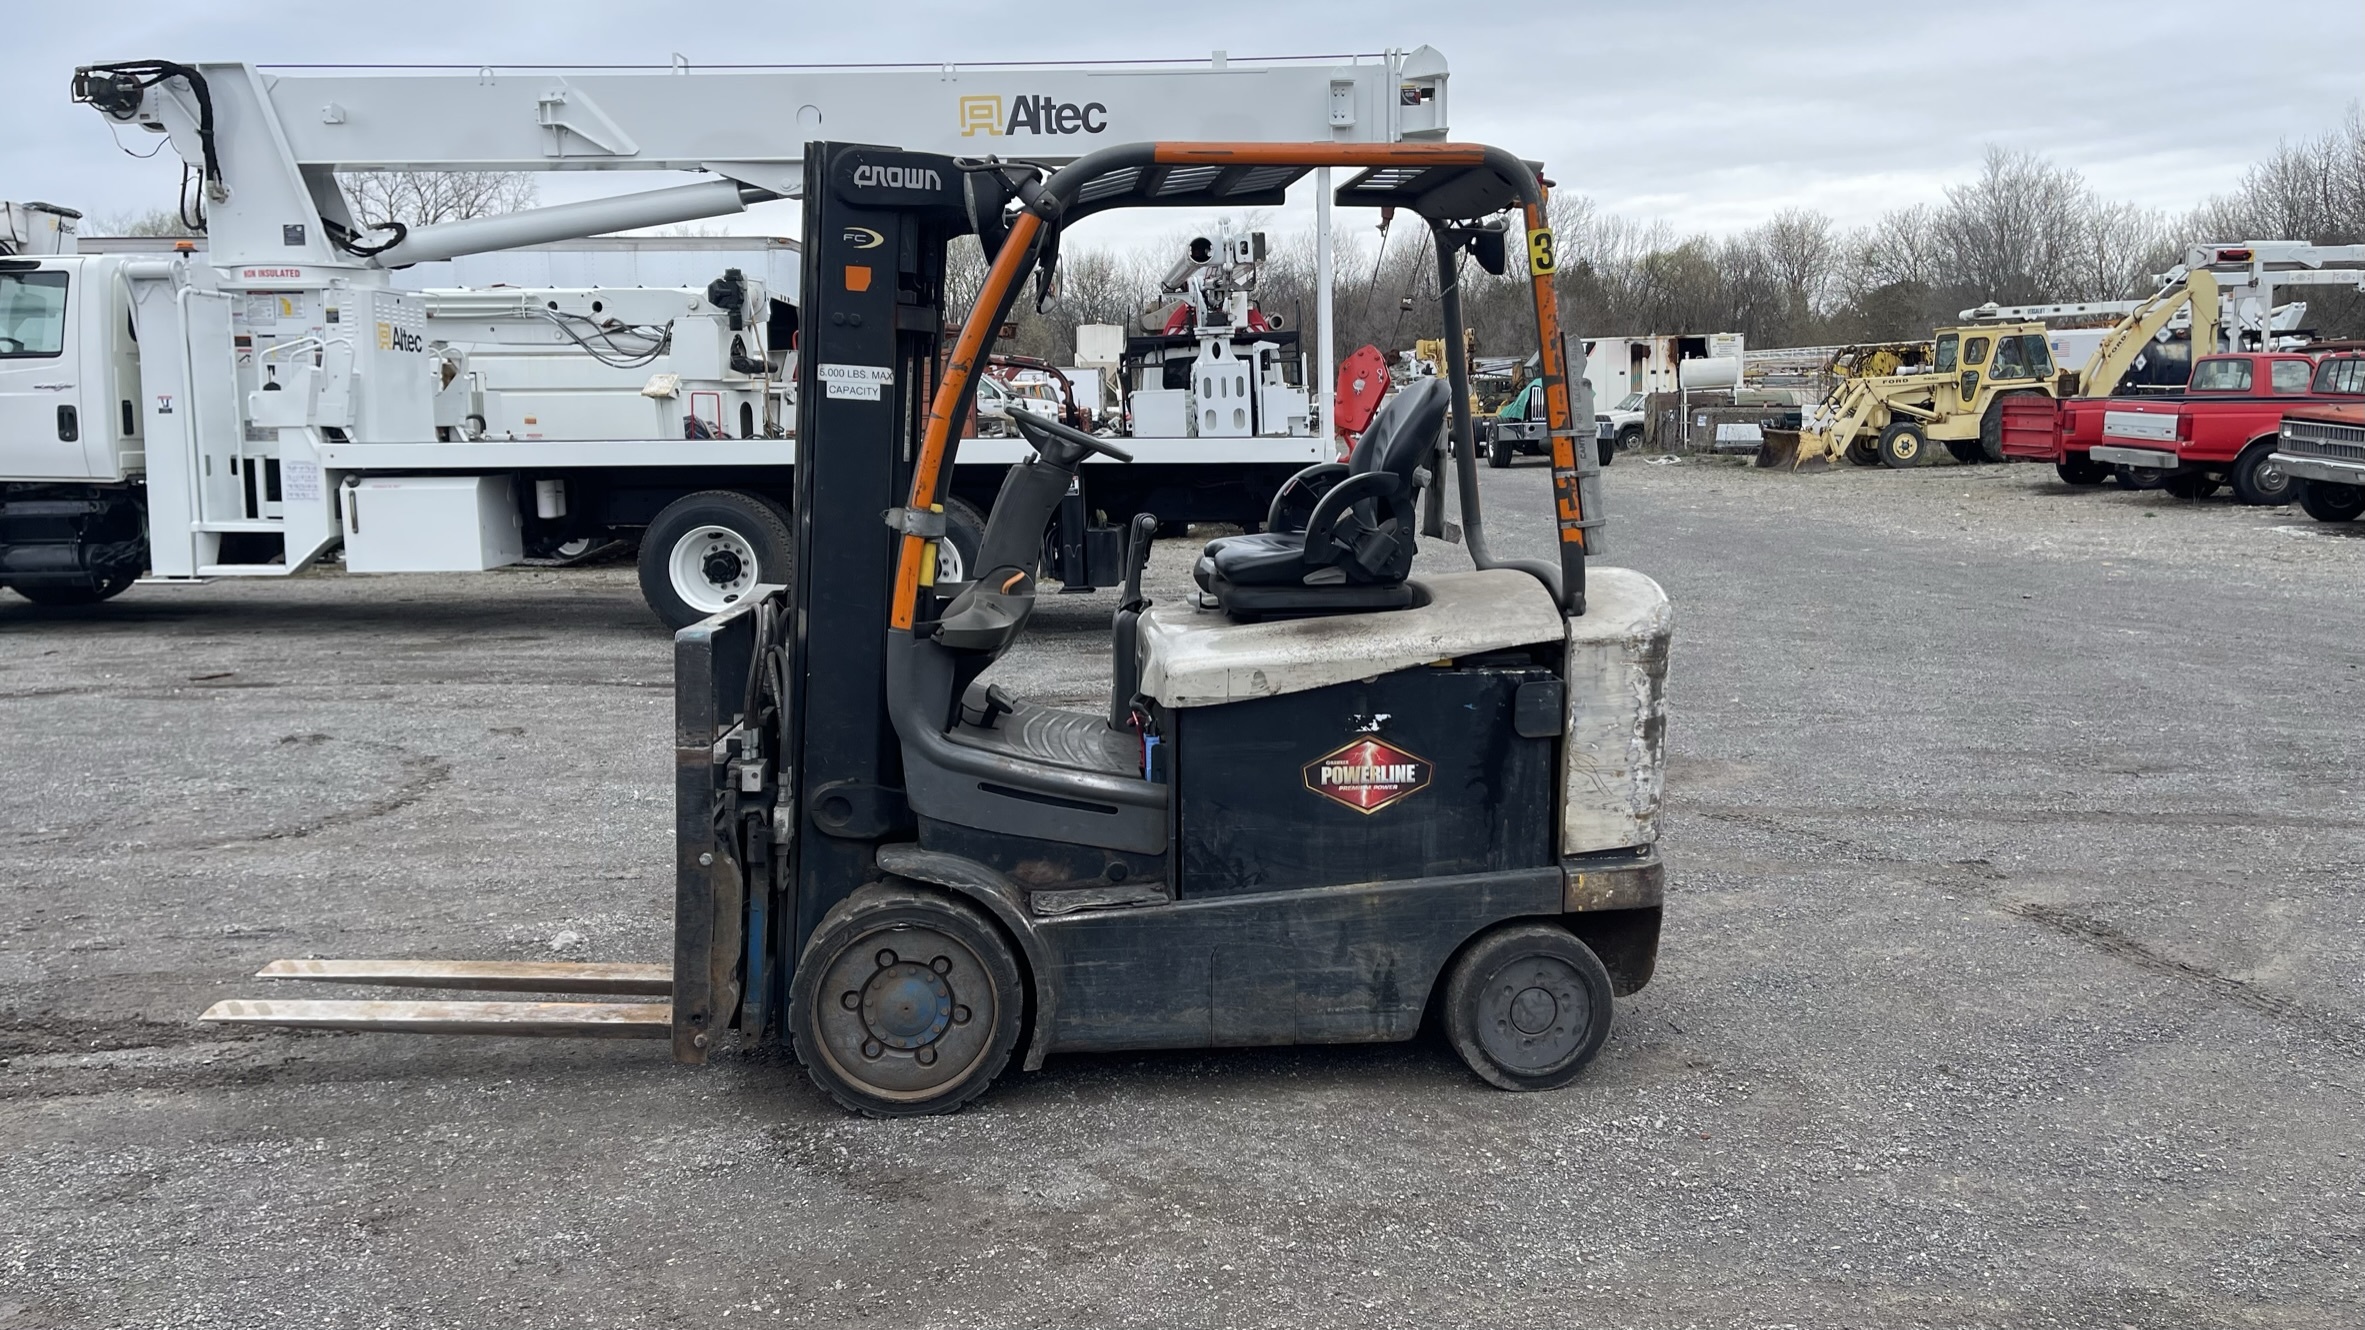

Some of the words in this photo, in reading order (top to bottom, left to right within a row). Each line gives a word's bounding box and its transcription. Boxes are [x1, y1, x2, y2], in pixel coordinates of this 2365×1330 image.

[1005, 95, 1107, 135] Altec
[843, 233, 867, 242] FC
[1535, 232, 1554, 270] 3
[244, 269, 256, 278] NON
[258, 269, 300, 278] INSULATED
[392, 326, 422, 353] Altec
[2107, 335, 2127, 358] FORD
[828, 385, 878, 396] CAPACITY
[1321, 764, 1416, 785] POWERLINE
